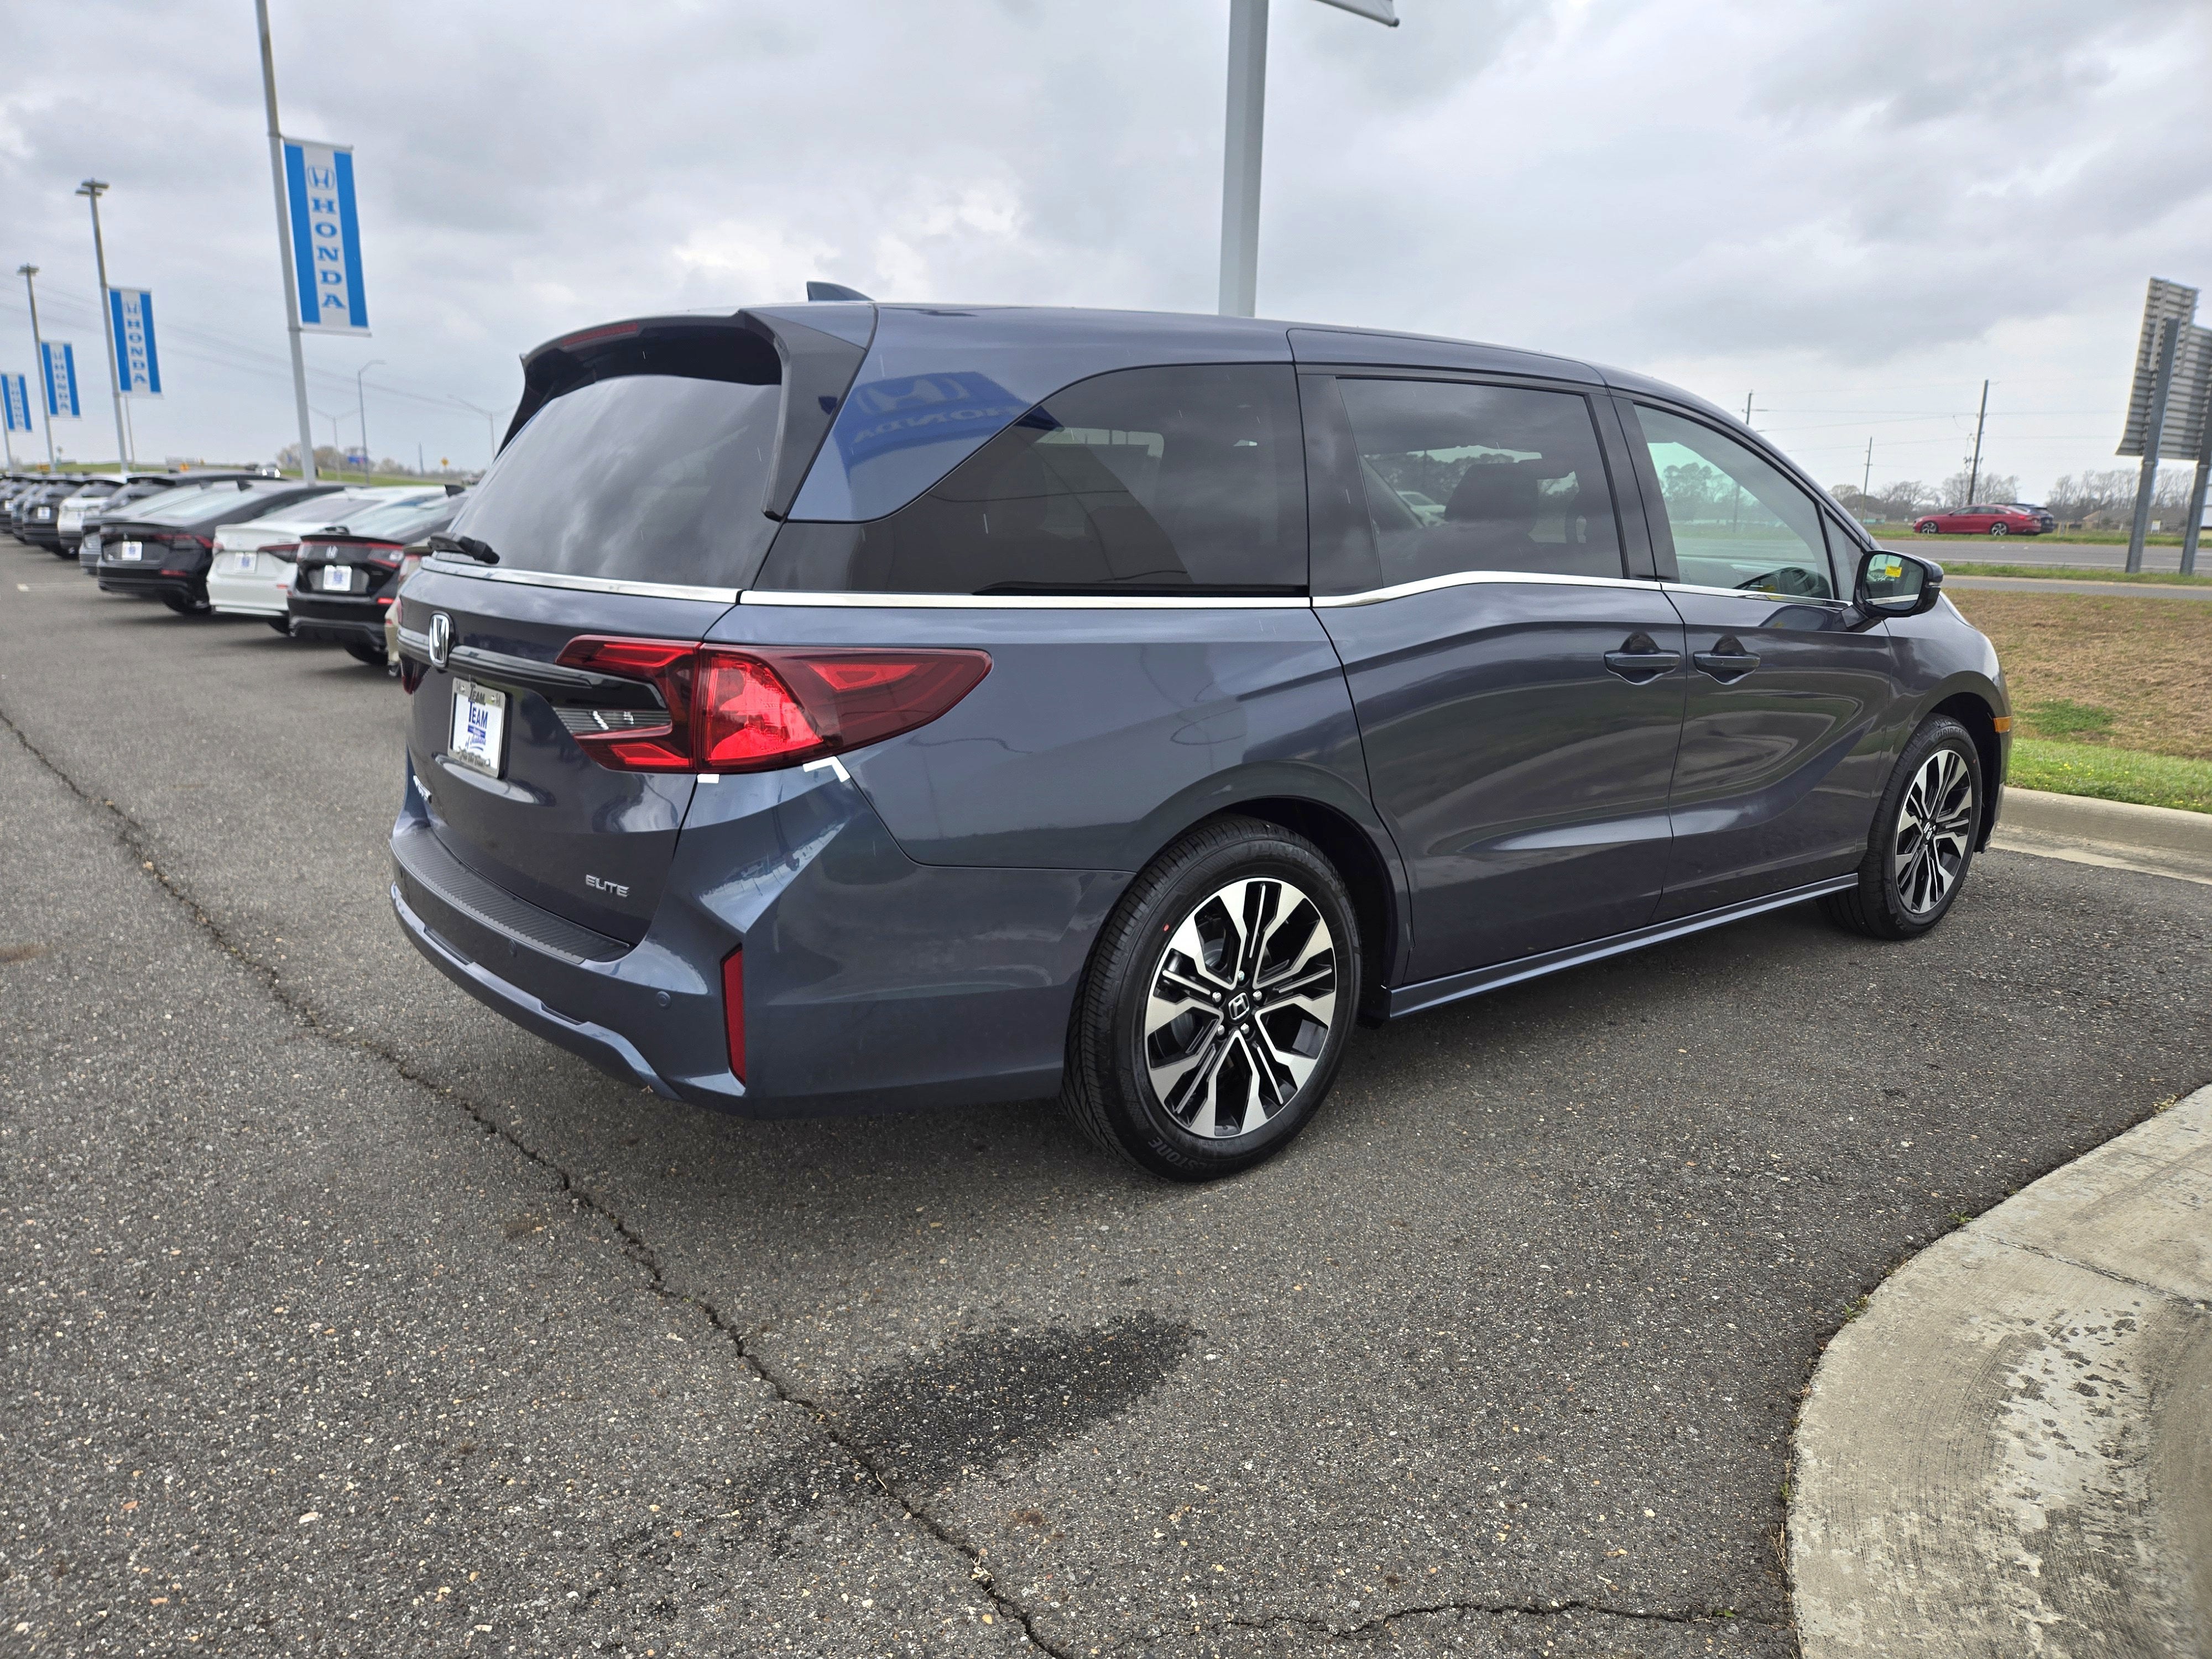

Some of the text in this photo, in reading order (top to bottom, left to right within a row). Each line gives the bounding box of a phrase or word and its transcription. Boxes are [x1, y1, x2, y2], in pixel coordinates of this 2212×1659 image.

[312, 197, 346, 310] HONDA
[127, 318, 147, 383] HONDA
[469, 684, 486, 705] TEAM
[468, 698, 488, 729] TEAM
[586, 874, 629, 898] ELITE
